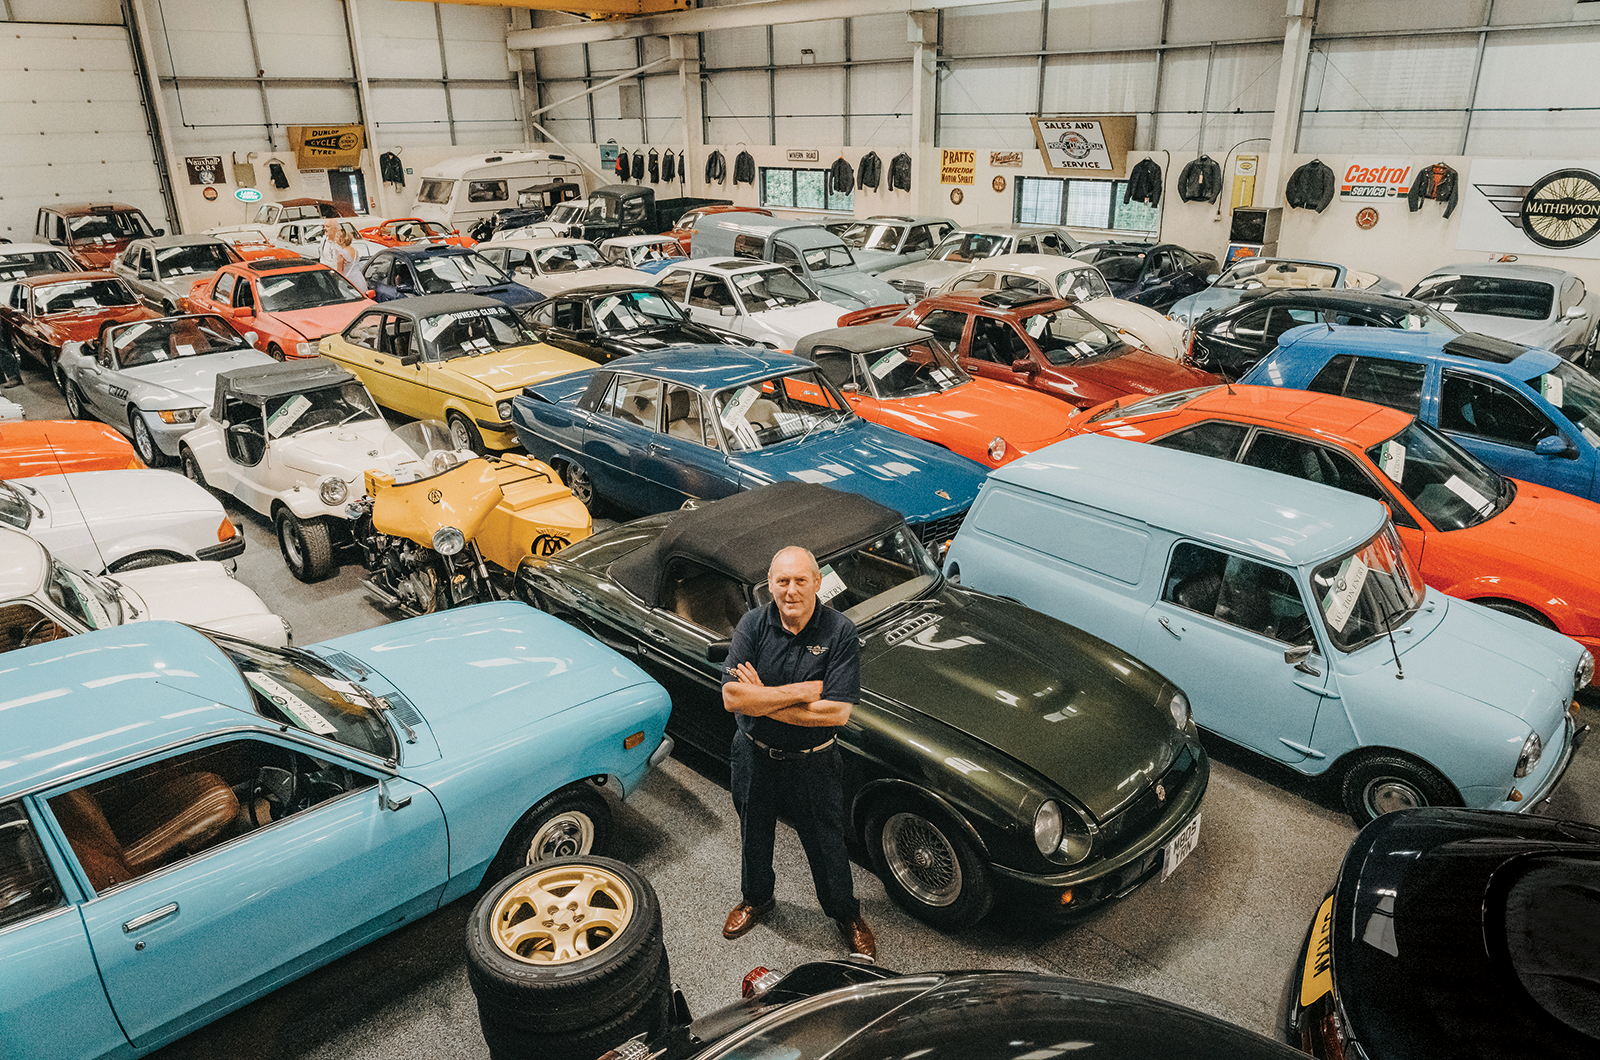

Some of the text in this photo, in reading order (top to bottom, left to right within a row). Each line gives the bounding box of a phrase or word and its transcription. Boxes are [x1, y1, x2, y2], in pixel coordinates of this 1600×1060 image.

[310, 138, 337, 147] CYCLE
[187, 157, 220, 166] Vauxhall
[943, 150, 975, 166] PRATTS
[1344, 164, 1411, 184] Castrol
[1351, 186, 1386, 196] service
[1525, 201, 1600, 216] MATHEWSON
[450, 309, 481, 320] OWNERS
[480, 307, 499, 316] CLUB
[1334, 566, 1365, 626] AUCTION ENTRY
